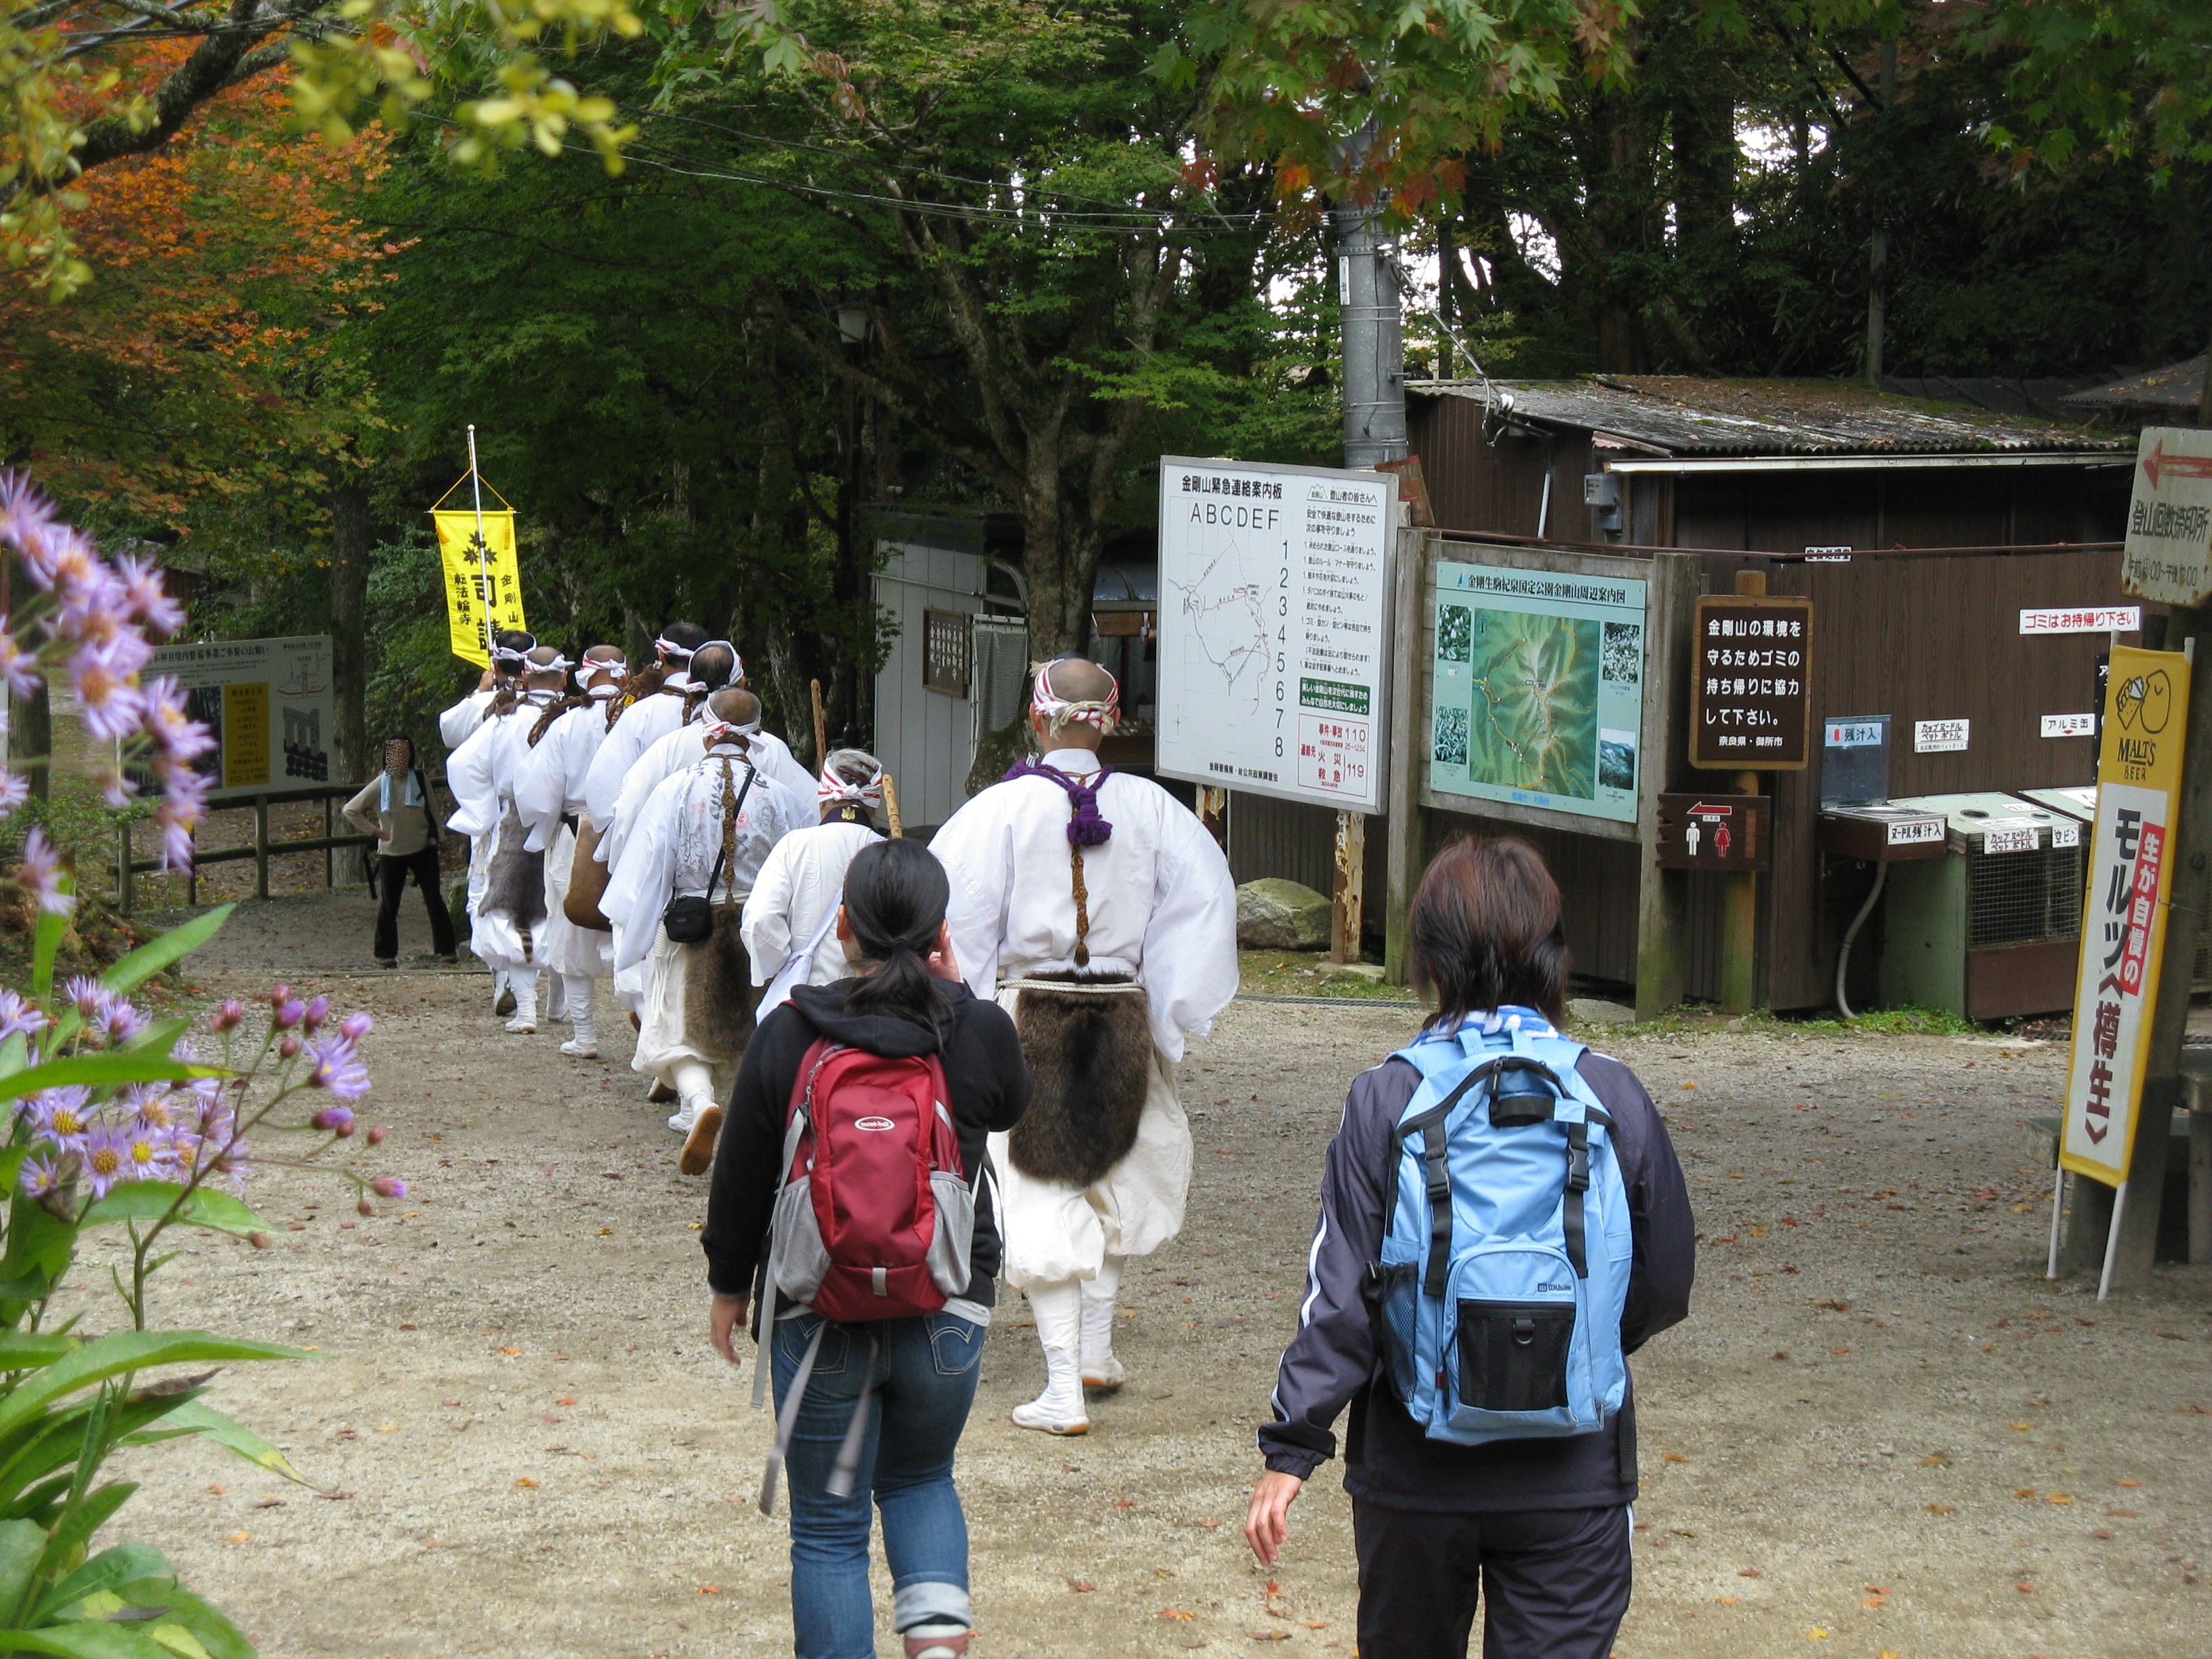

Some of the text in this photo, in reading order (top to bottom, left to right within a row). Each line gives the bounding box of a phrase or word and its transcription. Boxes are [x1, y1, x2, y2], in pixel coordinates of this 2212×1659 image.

[1182, 475, 1283, 499] 金剛山緊急連絡案内板
[1330, 490, 1377, 503] 登山者の皆さんへ
[1283, 539, 1288, 560] 1
[1280, 568, 1288, 588] 2
[454, 573, 472, 625] 転法輪寺
[500, 575, 518, 623] 金剛山
[1279, 596, 1288, 616] 3
[1708, 619, 1801, 637] 金剛山の環境を
[2025, 611, 2135, 629] ゴミはお持帰り下さい
[1277, 625, 1286, 644] 4
[1277, 653, 1285, 672] 5
[1707, 649, 1800, 666] 守るためゴミの
[1276, 681, 1284, 701] 6
[1706, 678, 1799, 695] 持ち帰りに協力
[1275, 708, 1284, 729] 7
[1706, 708, 1778, 725] して下さい。
[2048, 718, 2089, 729] アルミ缶
[1345, 727, 1366, 742] 110
[1719, 736, 1783, 747] 奈良県・御所市
[1844, 727, 1877, 741] 残汁入
[1275, 737, 1284, 757] 8
[2117, 737, 2156, 766] MALT'S
[1347, 763, 1364, 778] 119
[2125, 766, 2146, 780] BEER
[2054, 830, 2077, 844] 空ビン
[2123, 833, 2162, 985] 生が自慢の
